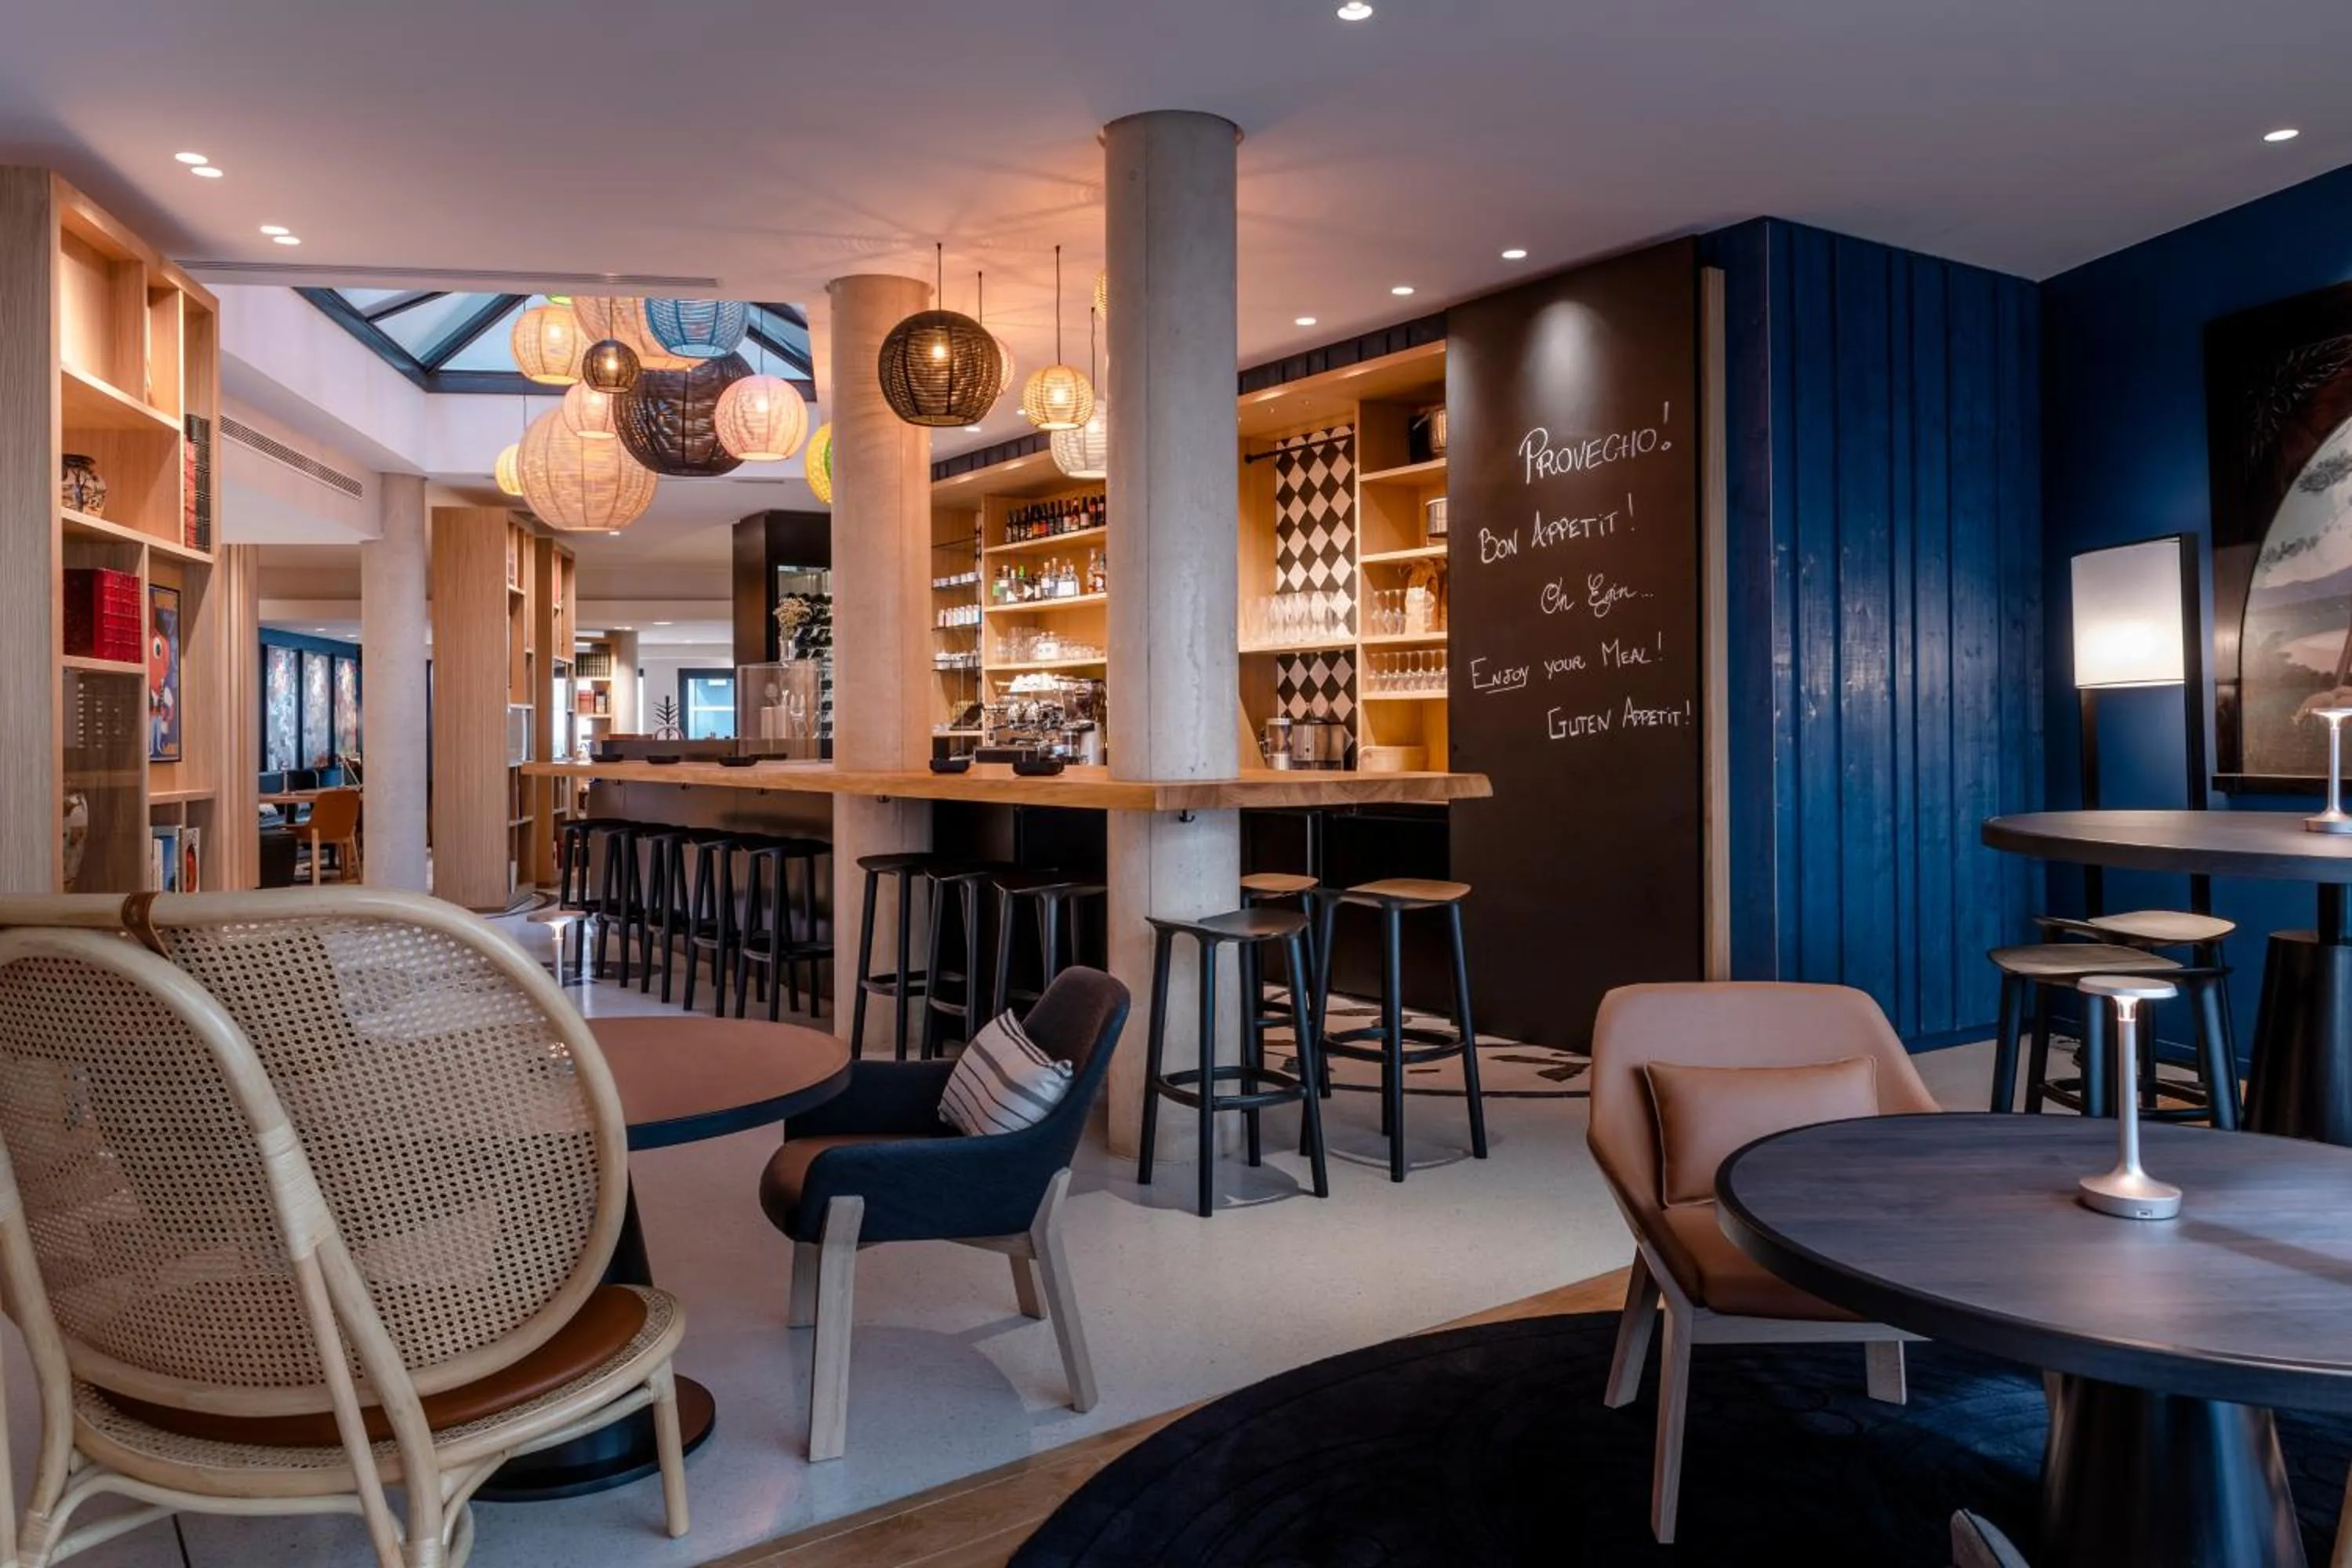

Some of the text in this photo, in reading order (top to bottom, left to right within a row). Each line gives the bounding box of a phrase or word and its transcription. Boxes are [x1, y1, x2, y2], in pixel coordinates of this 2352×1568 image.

[1518, 401, 1672, 485] PROVECHO!
[1479, 527, 1519, 564] BON
[1470, 656, 1530, 691] ENJOY
[1547, 706, 1612, 740] GUTEN
